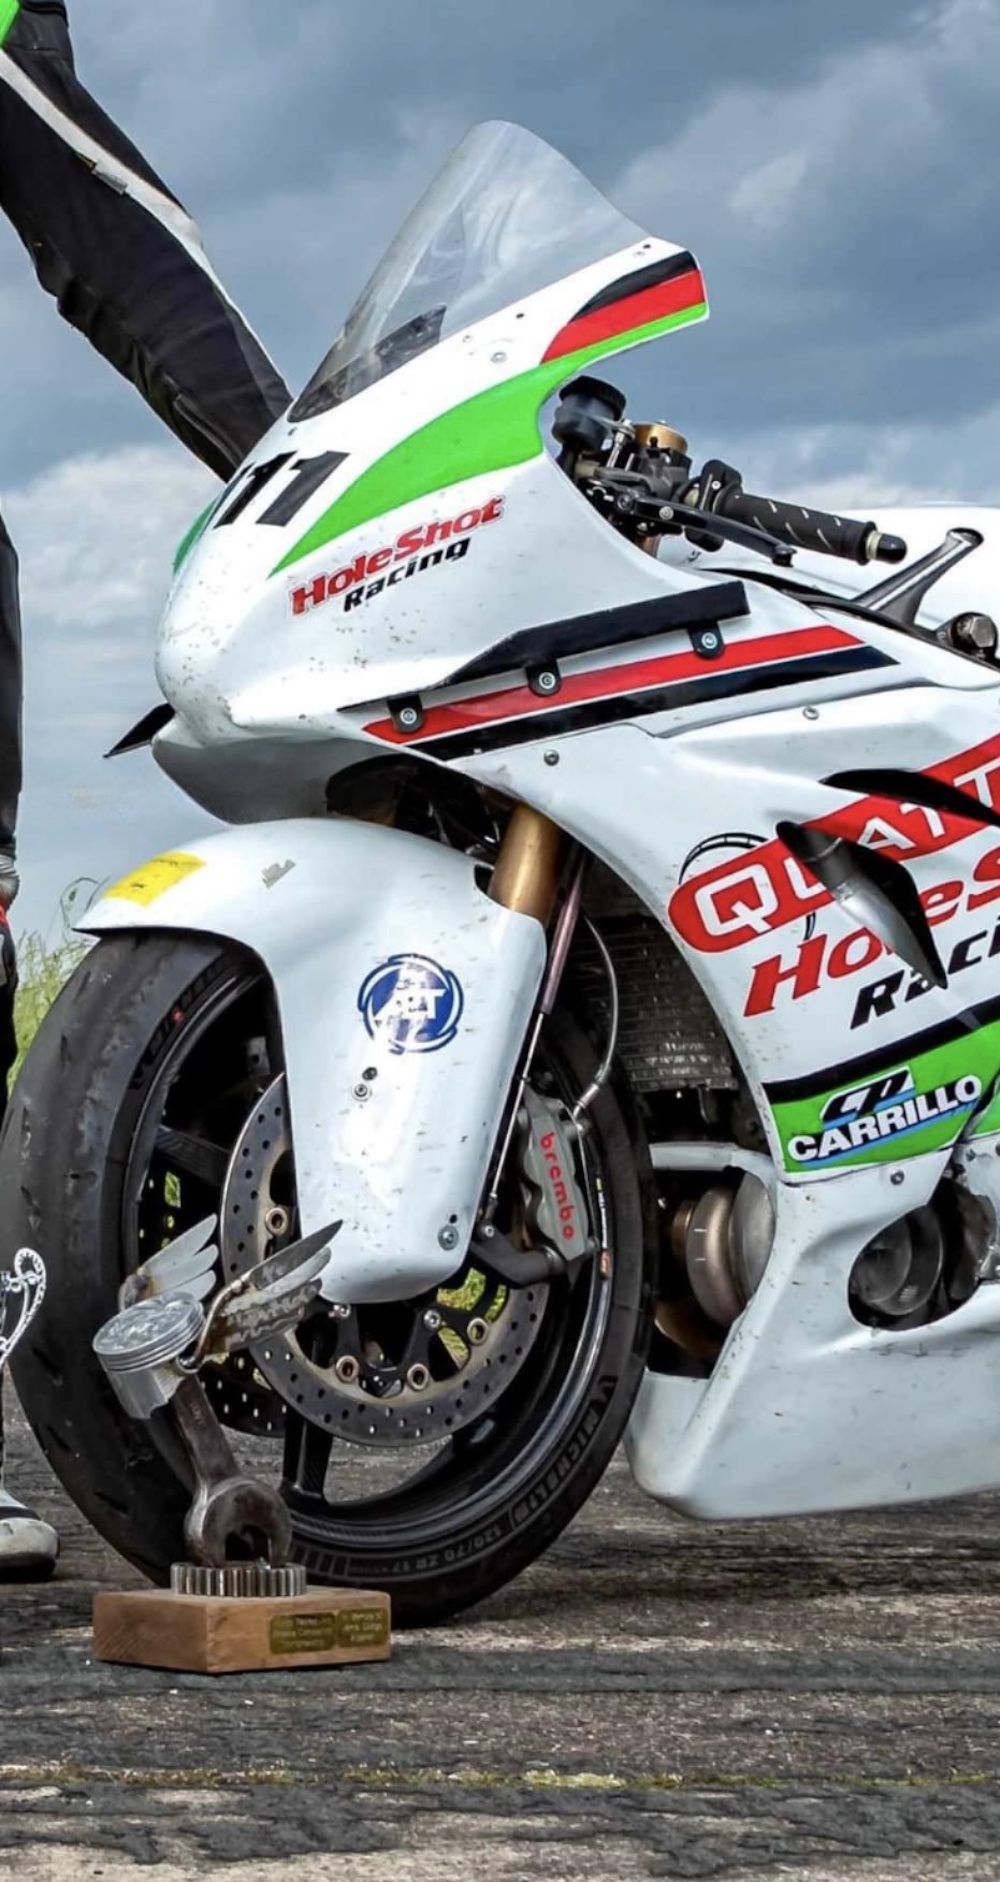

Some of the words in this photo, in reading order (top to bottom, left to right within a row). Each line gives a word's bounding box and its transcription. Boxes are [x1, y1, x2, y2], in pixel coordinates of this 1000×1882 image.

[291, 495, 506, 616] HoleShot
[342, 537, 472, 613] Racing
[787, 1074, 983, 1162] CARRILLO
[540, 1131, 575, 1240] brembo
